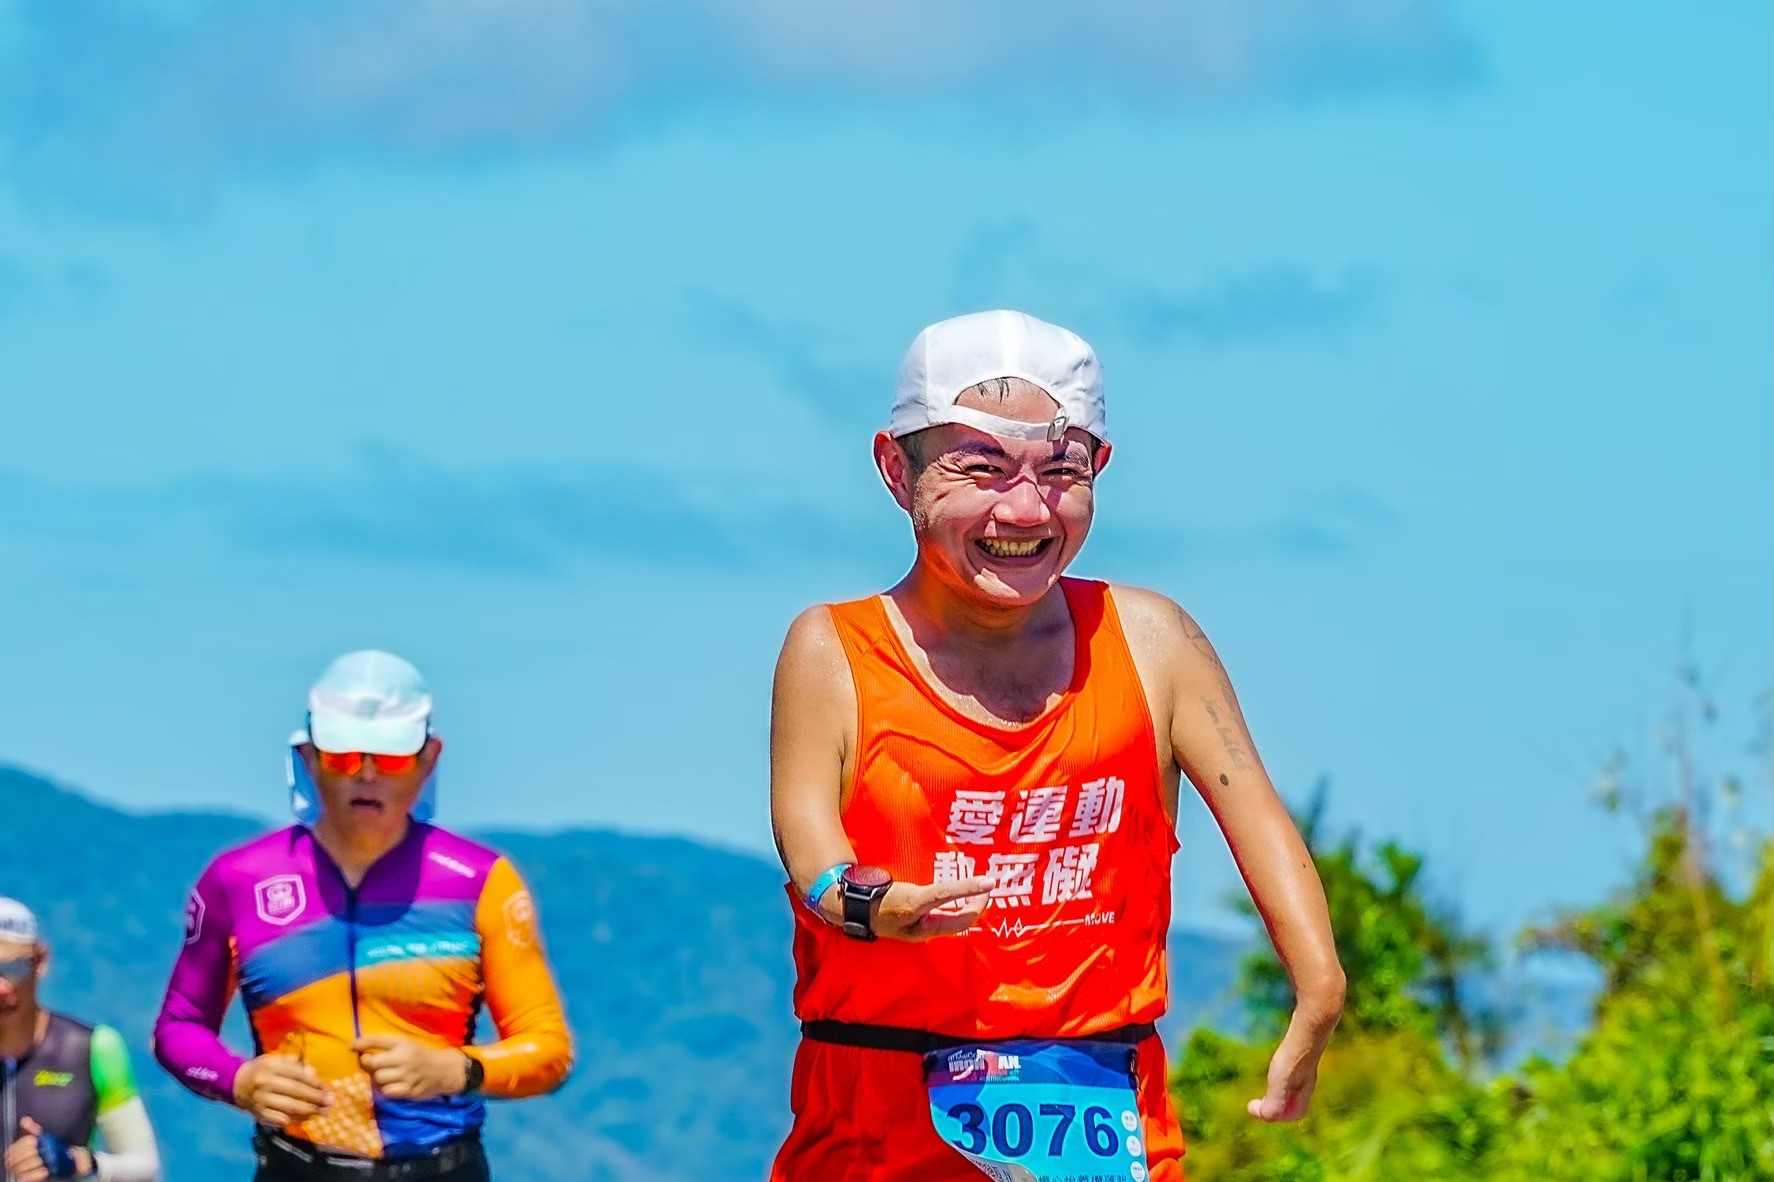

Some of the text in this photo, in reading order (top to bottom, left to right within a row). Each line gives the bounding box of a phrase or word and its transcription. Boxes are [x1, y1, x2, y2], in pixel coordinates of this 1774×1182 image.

[945, 776, 1125, 845] 愛運動
[1084, 911, 1115, 926] MOVE
[946, 1103, 1119, 1157] 3076
